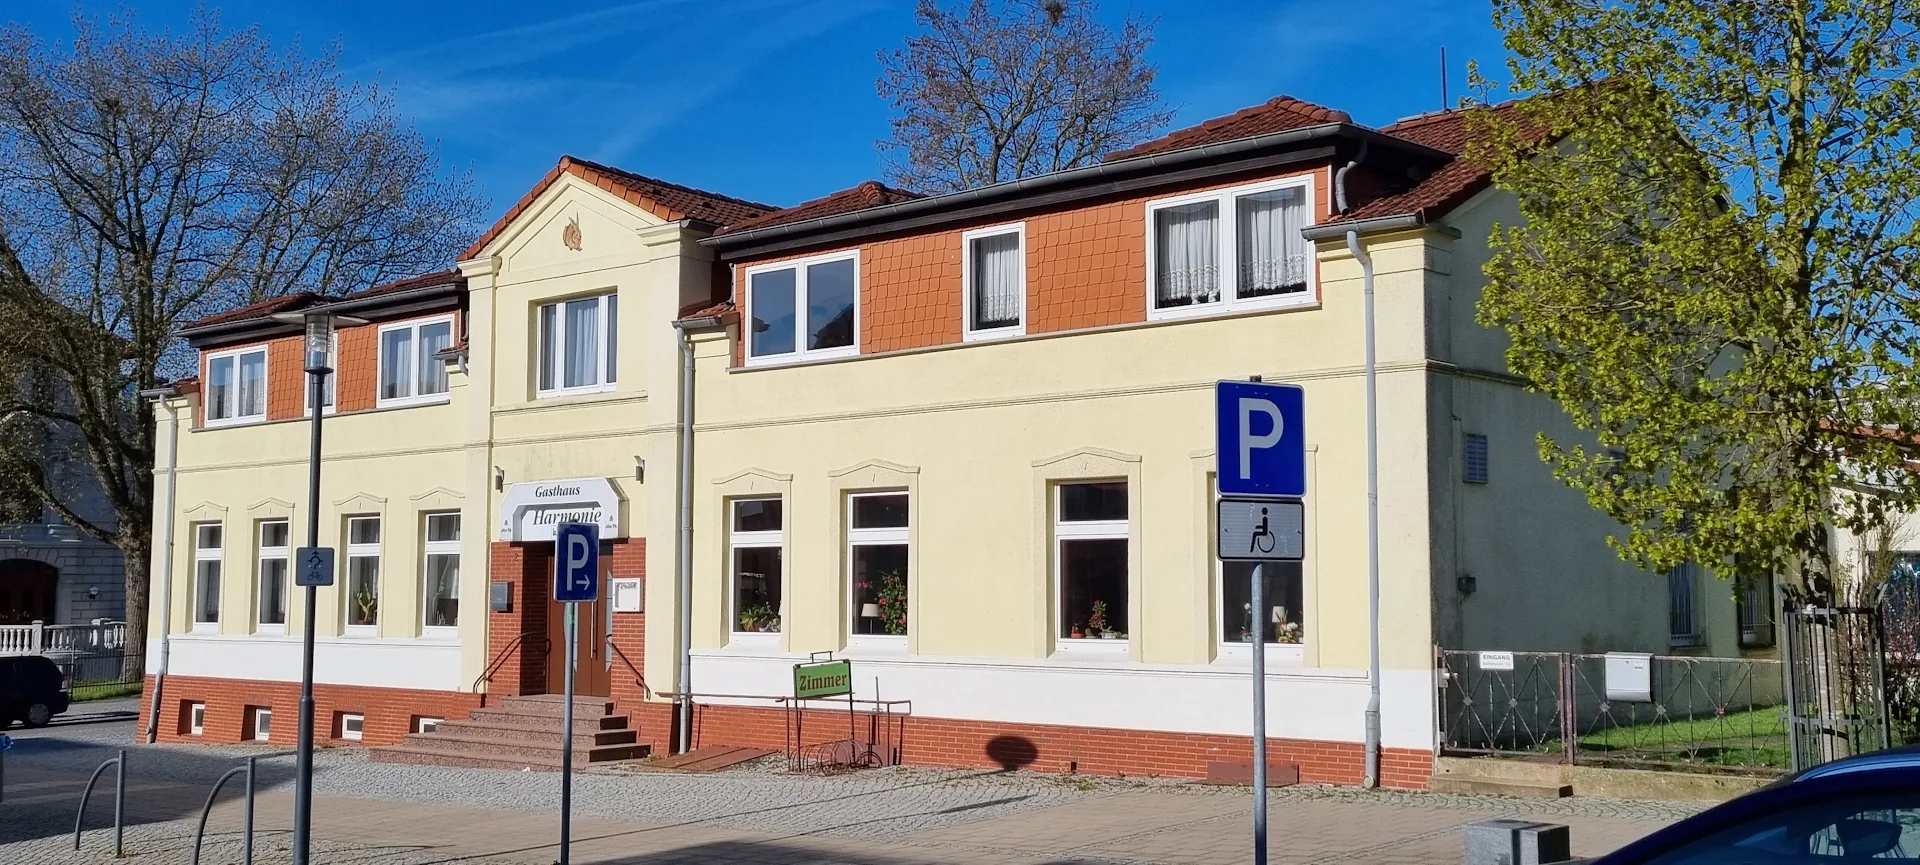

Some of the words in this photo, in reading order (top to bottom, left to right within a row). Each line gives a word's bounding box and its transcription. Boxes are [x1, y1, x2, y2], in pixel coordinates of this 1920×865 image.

[1238, 397, 1284, 480] P
[535, 484, 581, 498] Gasthaus
[532, 507, 602, 525] Harmonie
[566, 533, 589, 591] P
[799, 674, 847, 691] Zimmer
